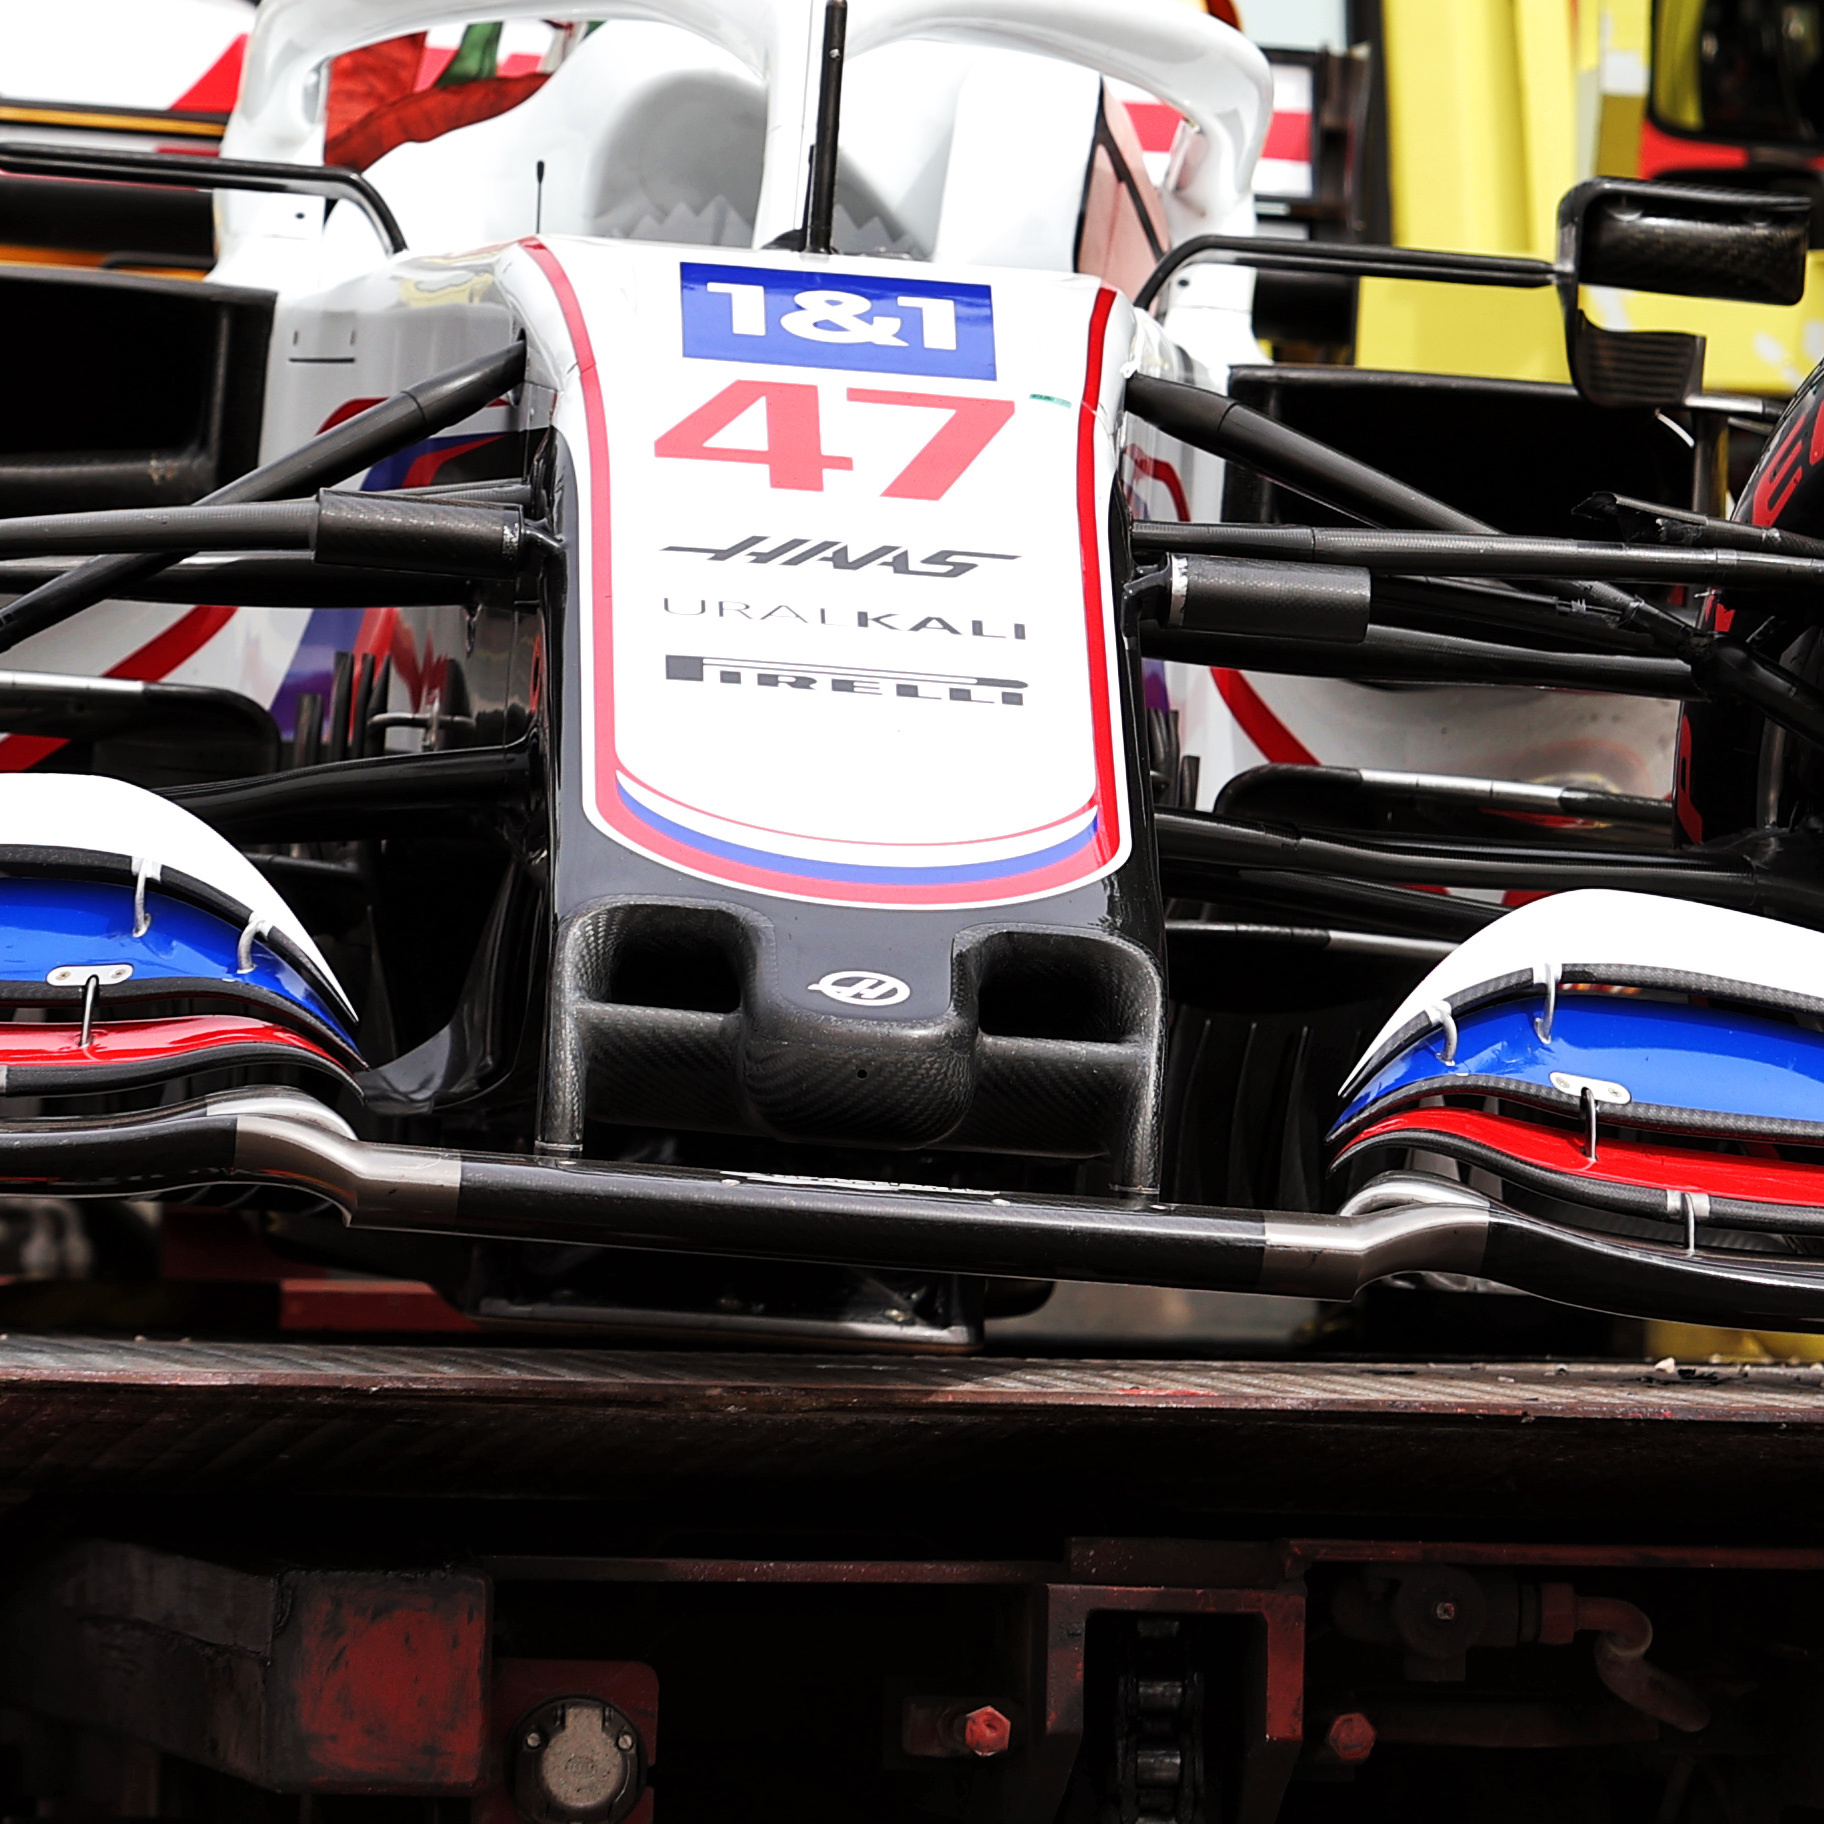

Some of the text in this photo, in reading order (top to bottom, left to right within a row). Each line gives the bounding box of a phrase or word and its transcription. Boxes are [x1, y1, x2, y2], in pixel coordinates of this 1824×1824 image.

[706, 281, 958, 351] 1&1
[653, 379, 1016, 502] 47
[659, 535, 1024, 579] HAAS
[663, 596, 1027, 641] URALKALI
[665, 653, 1029, 707] PIRELLI
